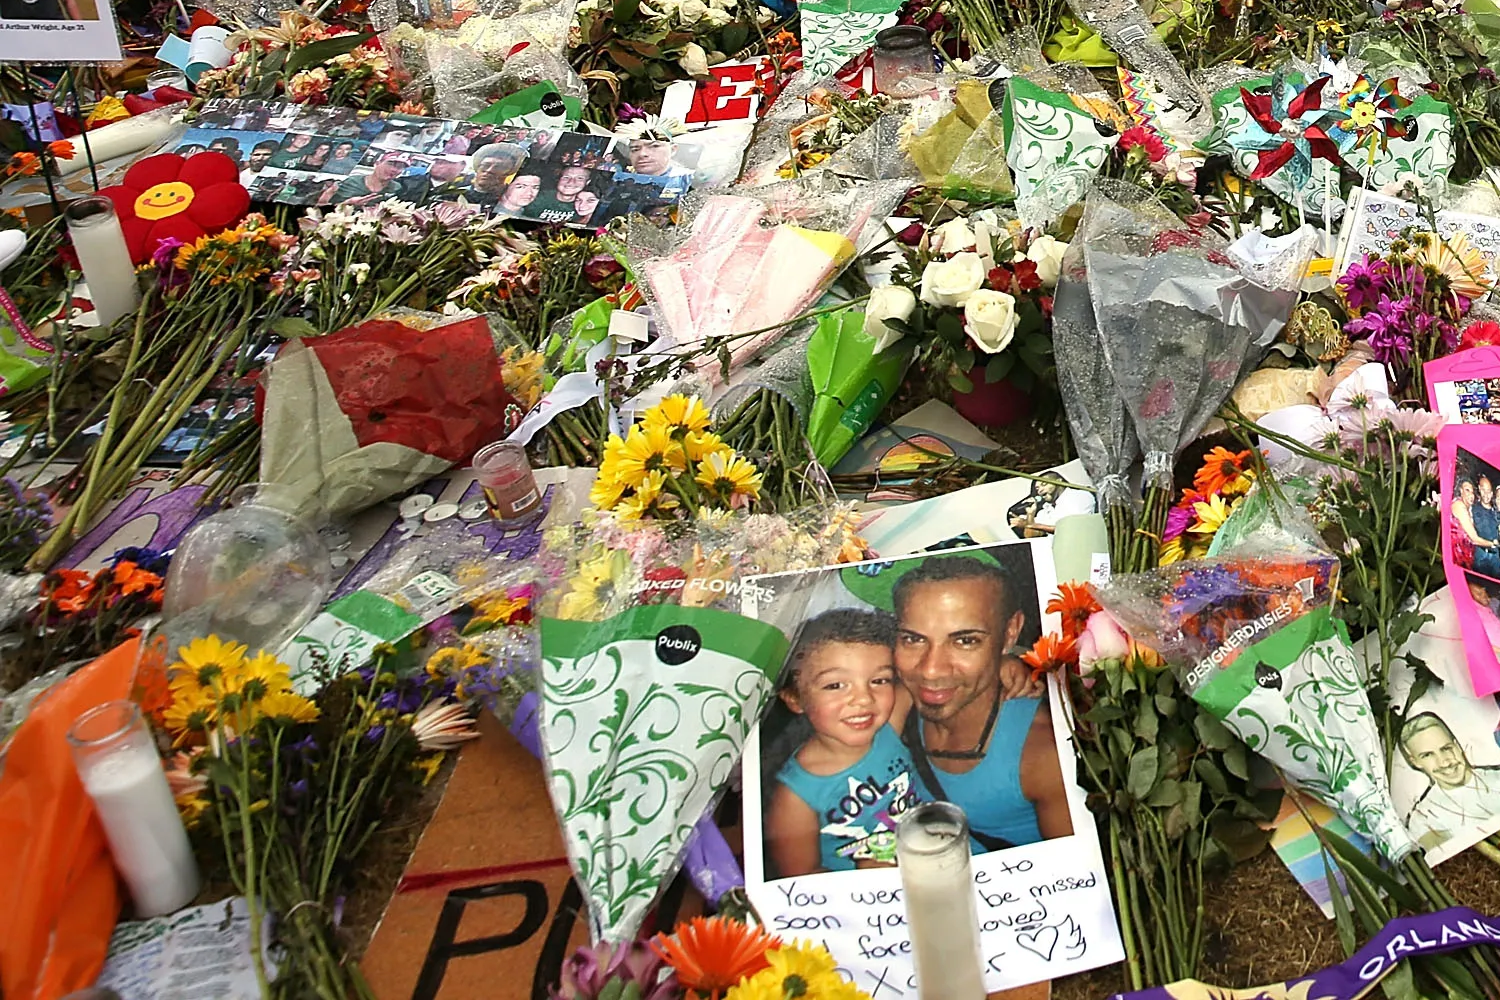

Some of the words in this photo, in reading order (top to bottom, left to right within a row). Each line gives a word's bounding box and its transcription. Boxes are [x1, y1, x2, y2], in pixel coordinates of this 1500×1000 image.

[61, 24, 75, 32] Age
[689, 578, 776, 603] FLOWERS
[658, 635, 698, 652] Publix
[826, 775, 891, 826] COOL
[777, 882, 828, 907] You
[850, 887, 904, 903] wer
[1001, 859, 1034, 876] to
[773, 914, 842, 931] soon
[978, 889, 1020, 908] be
[1029, 872, 1097, 898] missed
[979, 901, 1048, 932] oved
